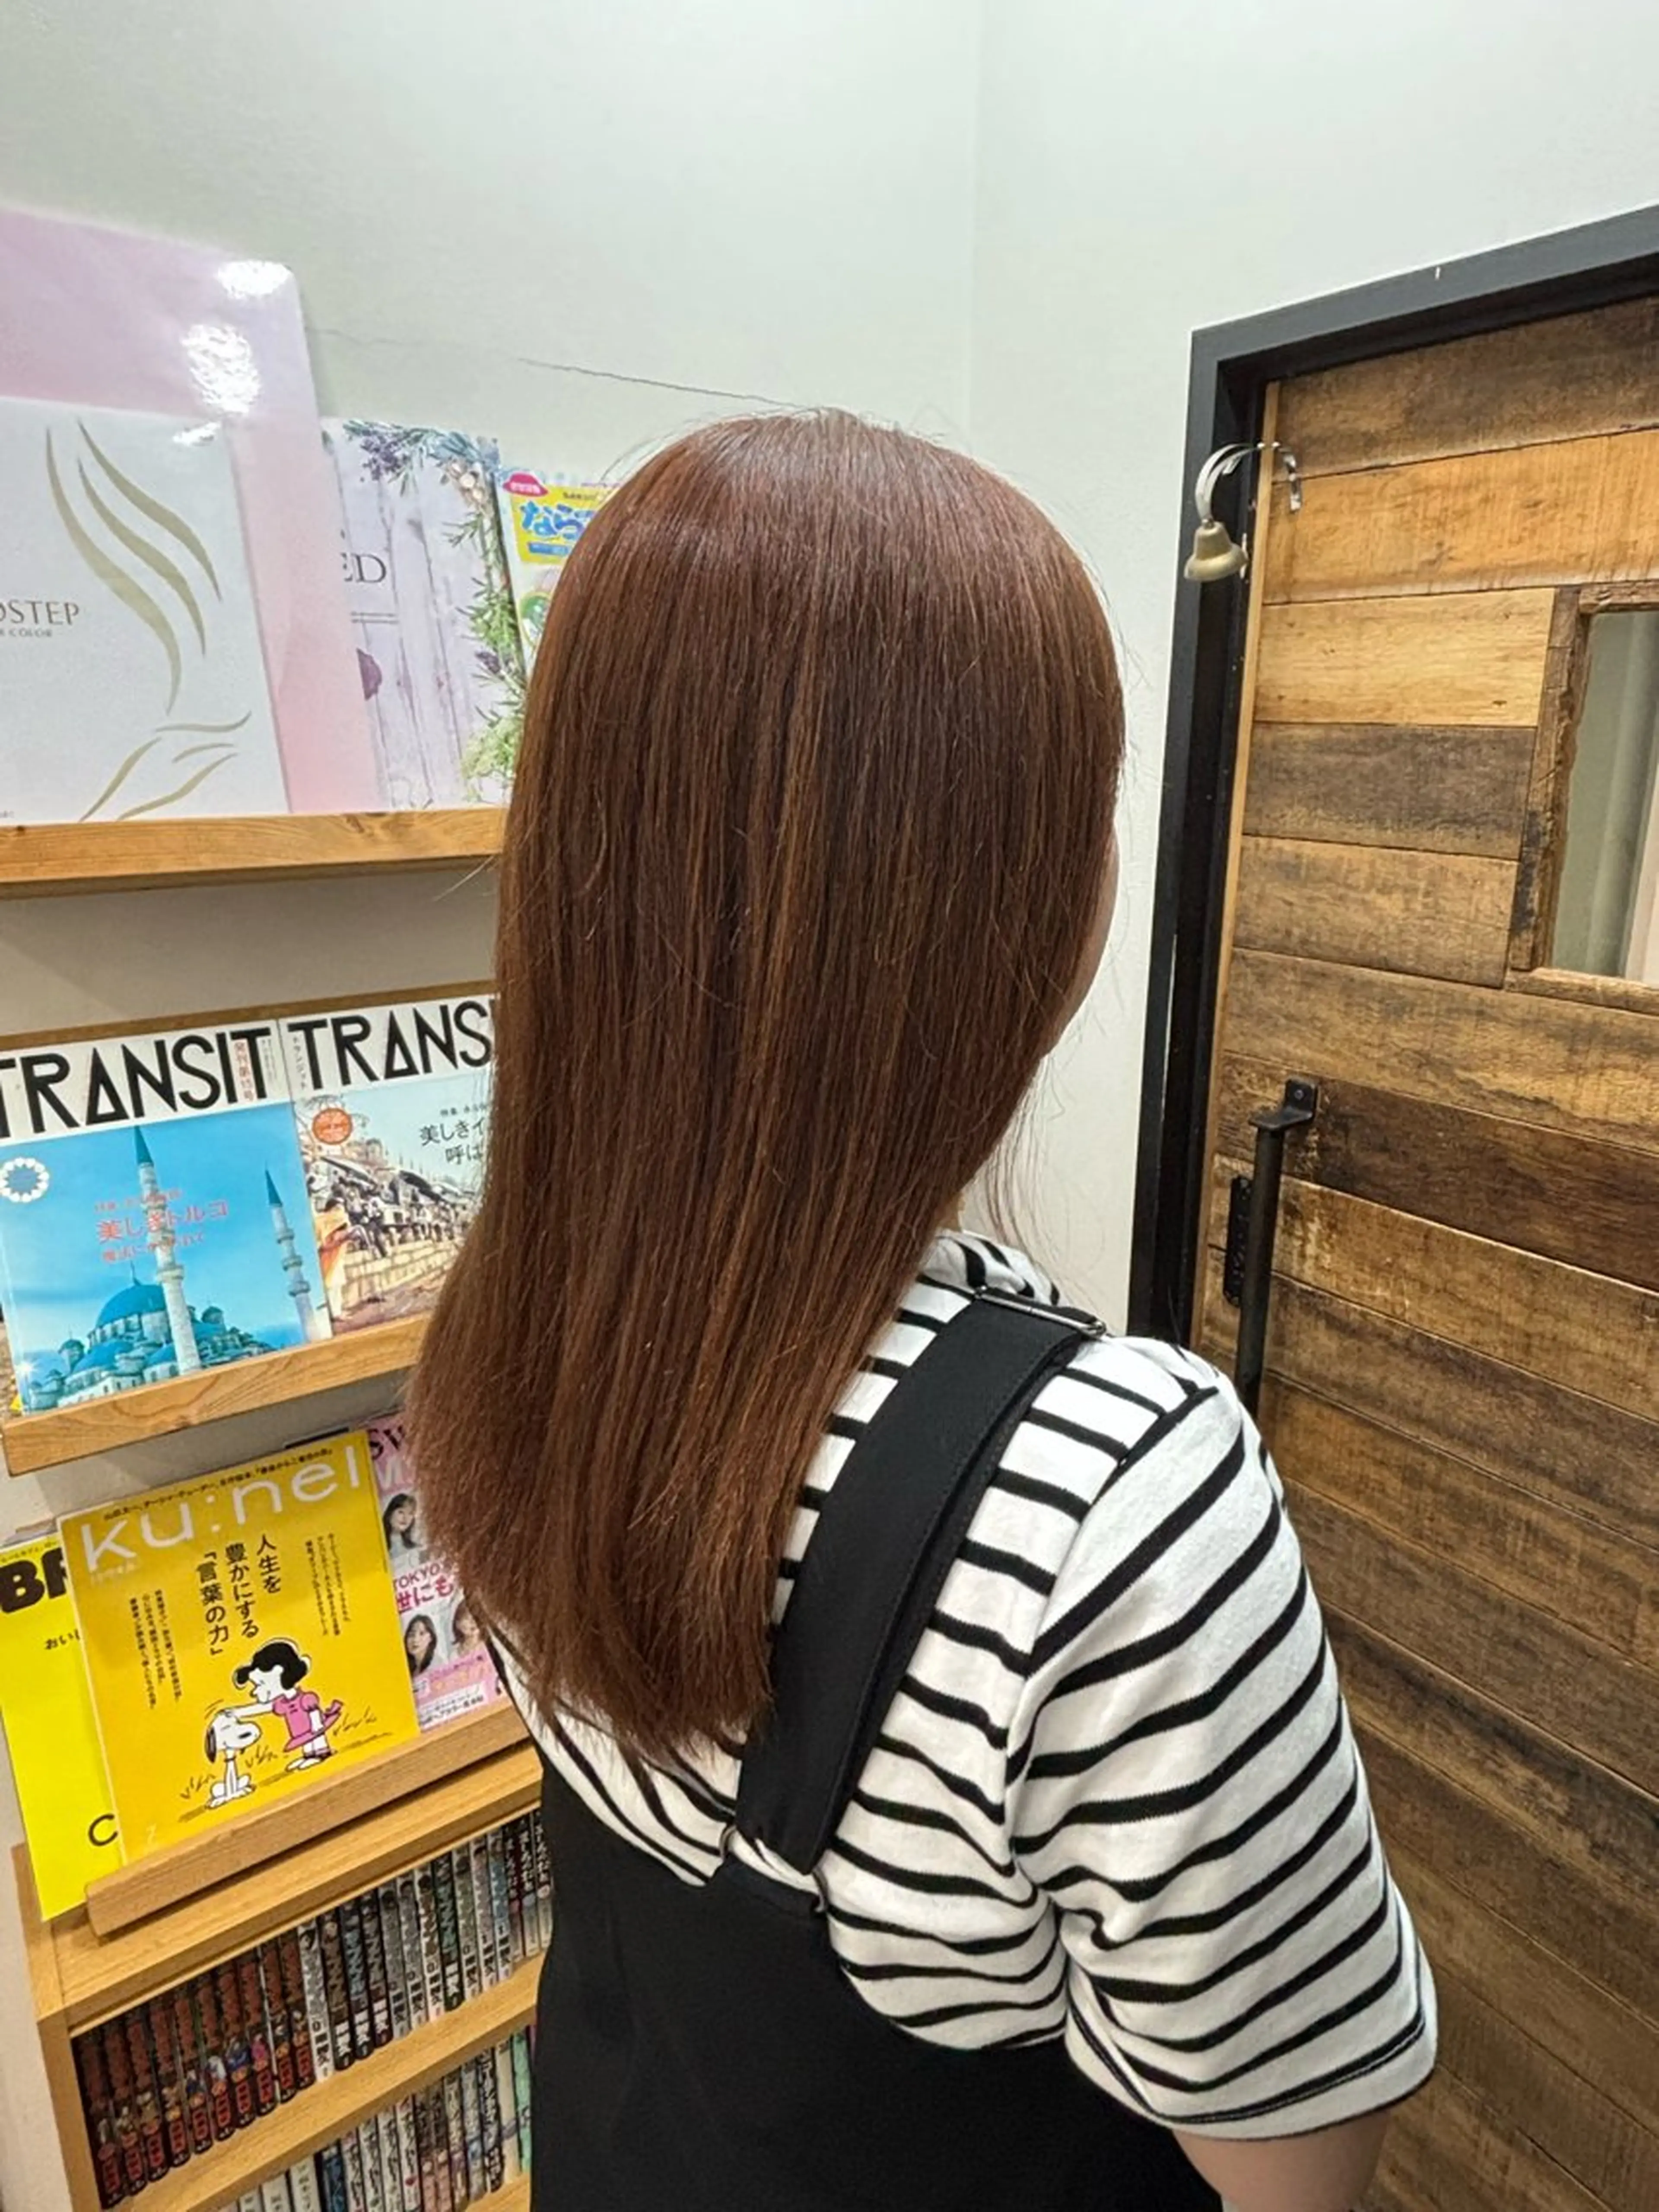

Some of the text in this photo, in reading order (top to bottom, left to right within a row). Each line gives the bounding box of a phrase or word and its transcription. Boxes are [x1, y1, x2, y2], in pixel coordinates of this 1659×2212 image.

[287, 999, 495, 1090] TRANS
[225, 1541, 260, 1638] 豊かにする
[257, 1533, 281, 1593] 人生を
